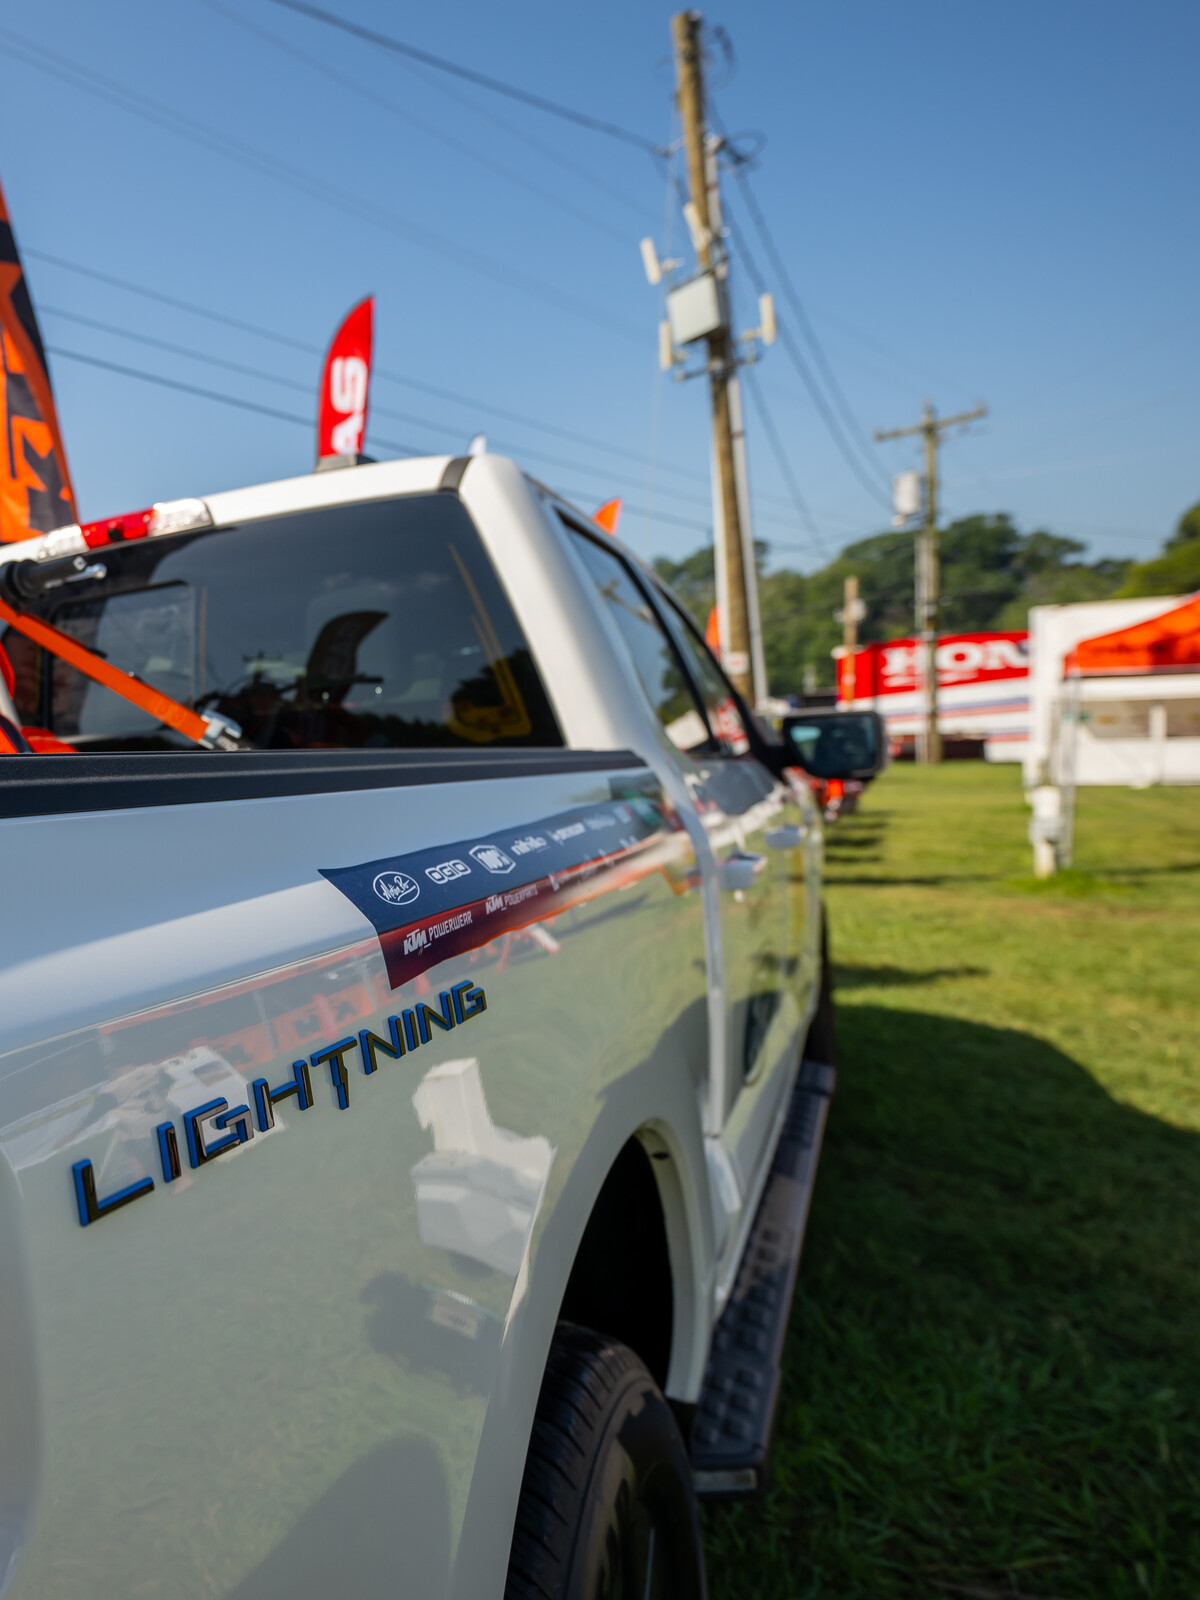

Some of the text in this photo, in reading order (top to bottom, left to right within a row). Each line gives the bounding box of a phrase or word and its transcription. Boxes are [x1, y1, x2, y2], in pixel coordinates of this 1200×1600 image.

[486, 895, 503, 914] KTM
[404, 911, 472, 955] KTM POWERWEAR
[72, 980, 487, 1227] LIGHTNING
